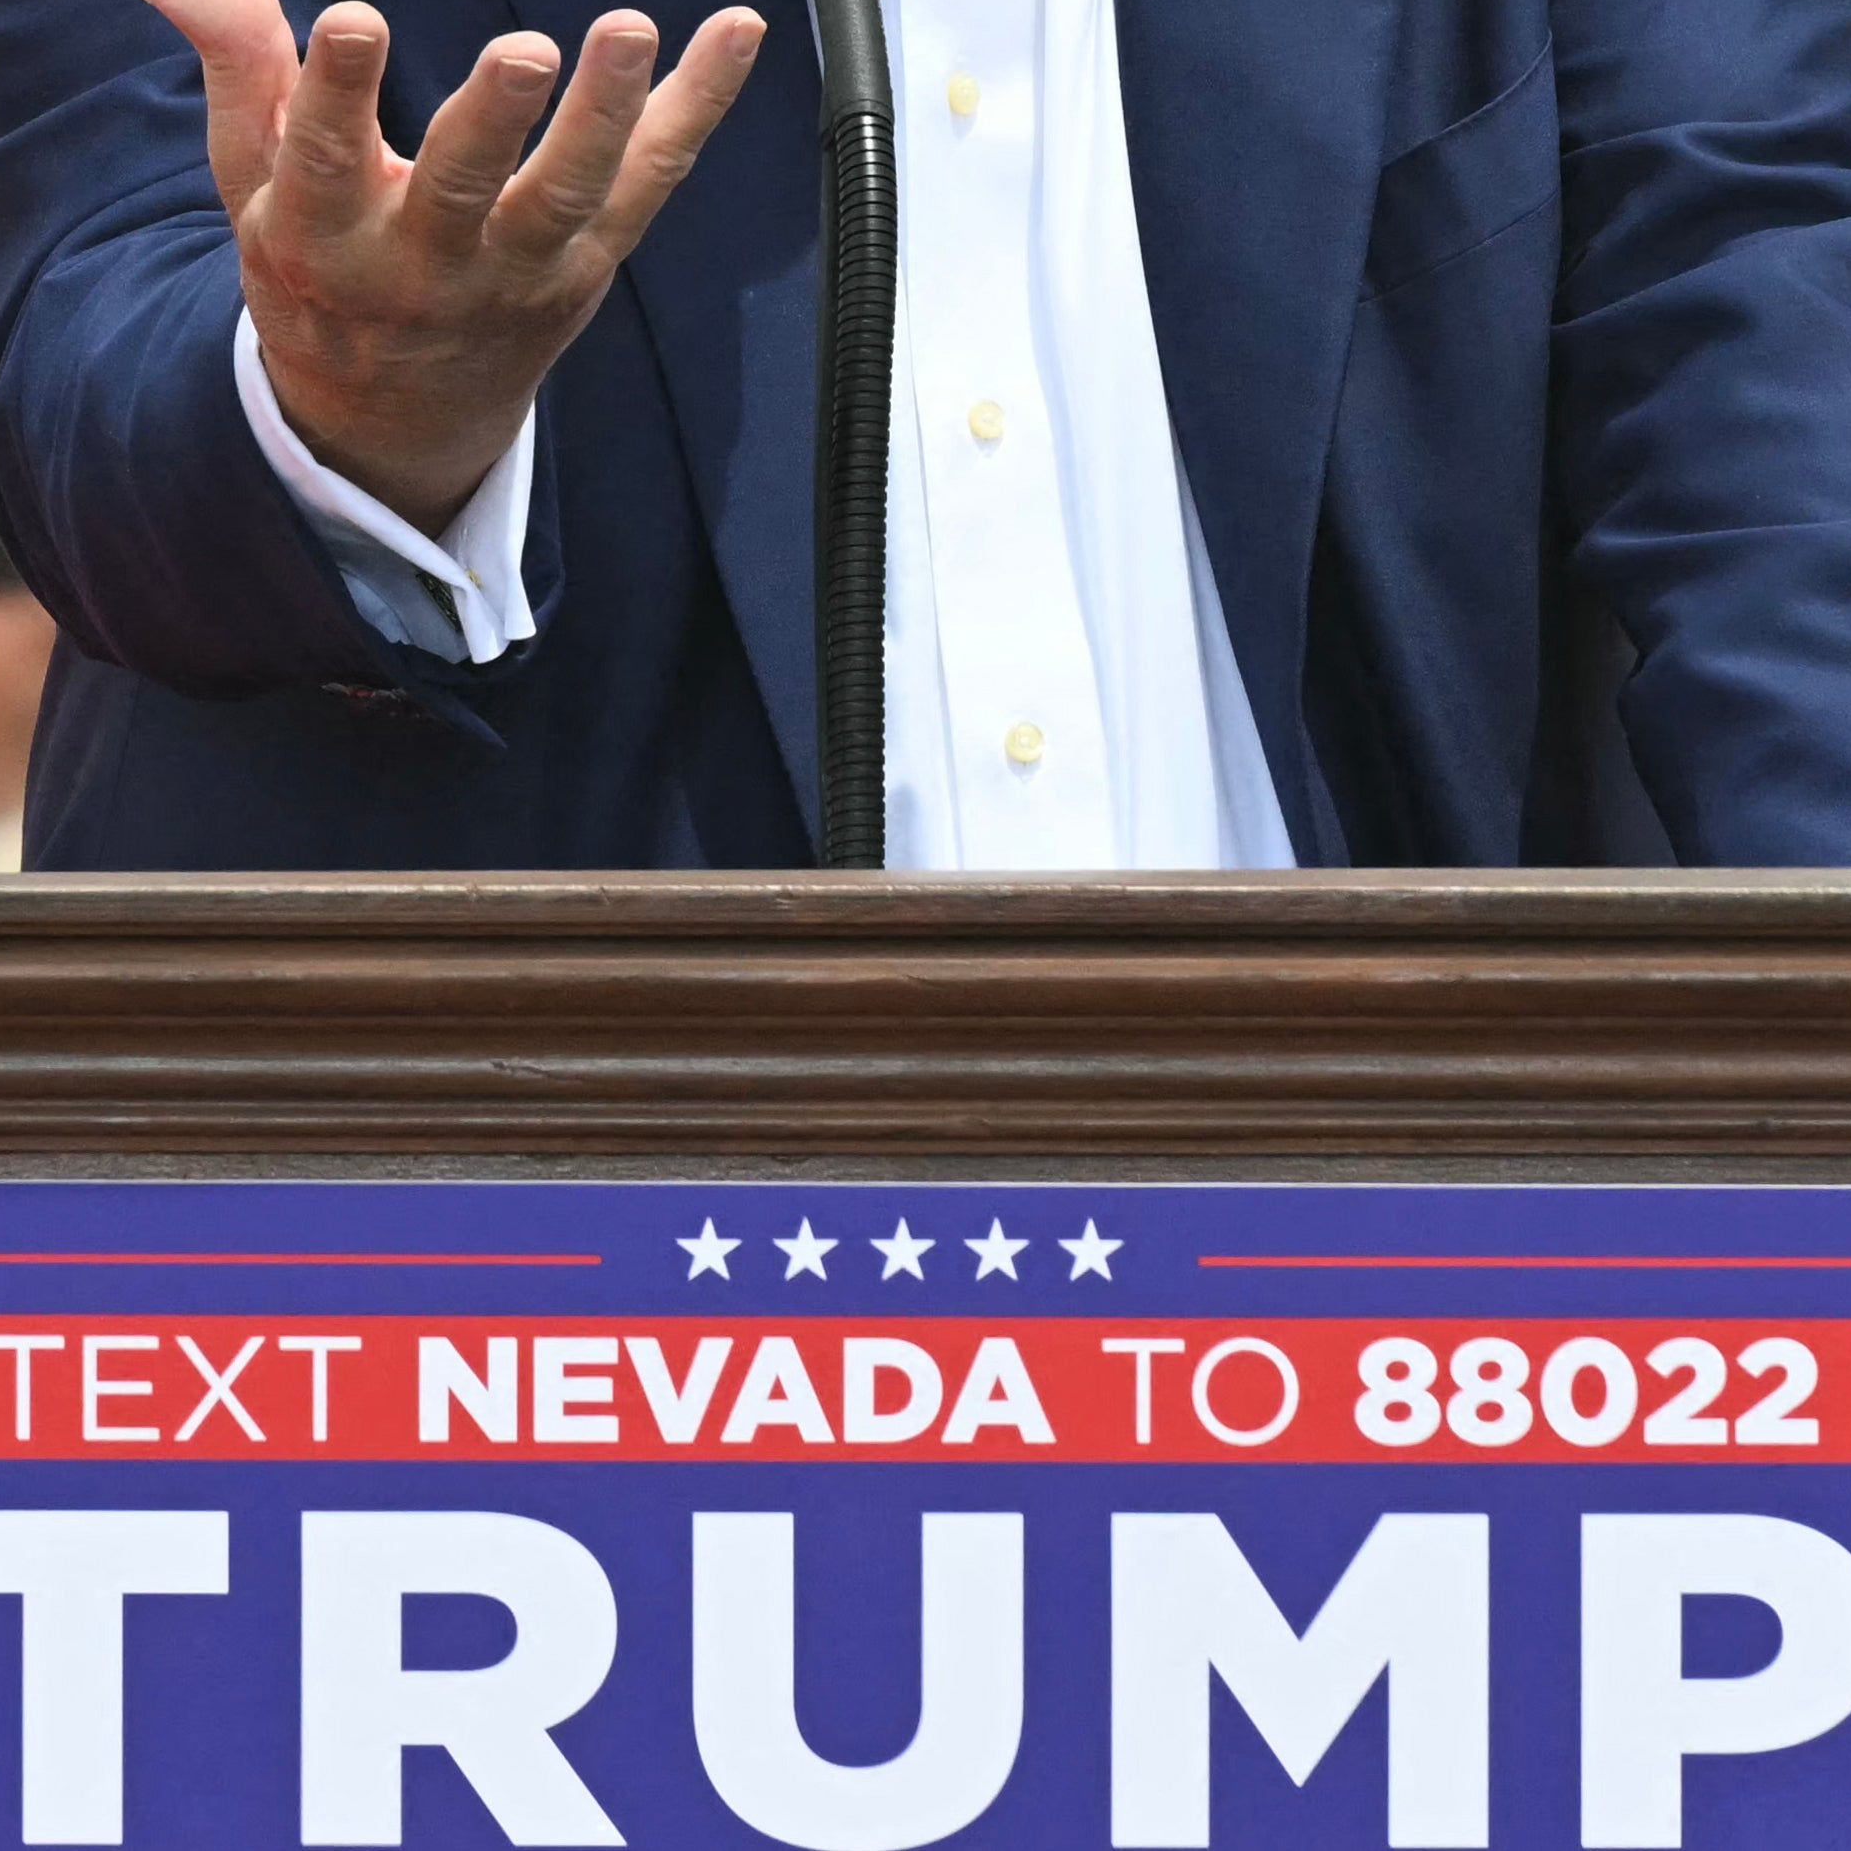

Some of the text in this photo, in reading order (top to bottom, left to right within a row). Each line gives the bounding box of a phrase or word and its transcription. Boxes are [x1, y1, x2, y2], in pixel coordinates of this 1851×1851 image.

[417, 1335, 1058, 1445] NEVADA
[1101, 1336, 1301, 1447] TO
[1353, 1335, 1821, 1448] 88022
